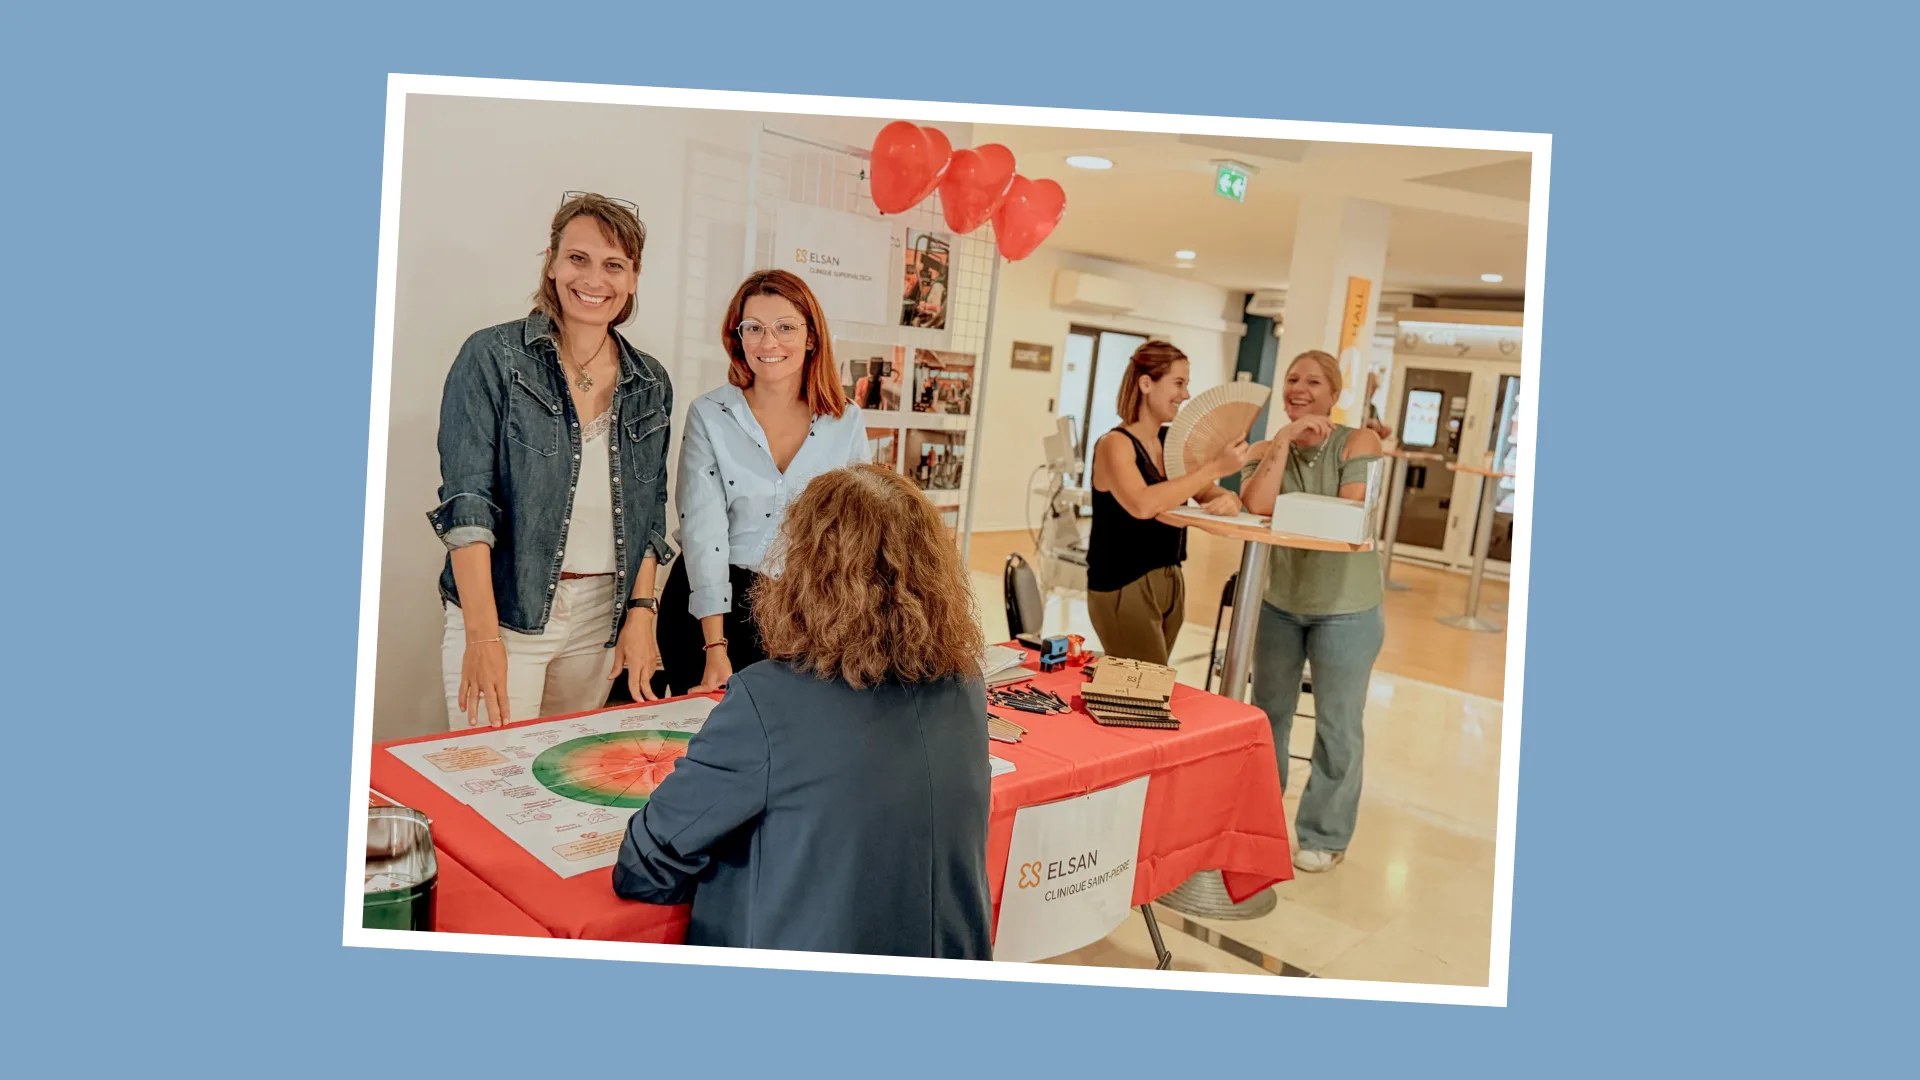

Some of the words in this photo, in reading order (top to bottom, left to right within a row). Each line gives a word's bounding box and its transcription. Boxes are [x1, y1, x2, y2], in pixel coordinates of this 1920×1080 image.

[809, 252, 840, 266] ELSAN
[1044, 880, 1087, 901] CLINIQUE
[1087, 859, 1131, 889] SAINT-PIERRE
[1047, 850, 1098, 880] ELSAN
